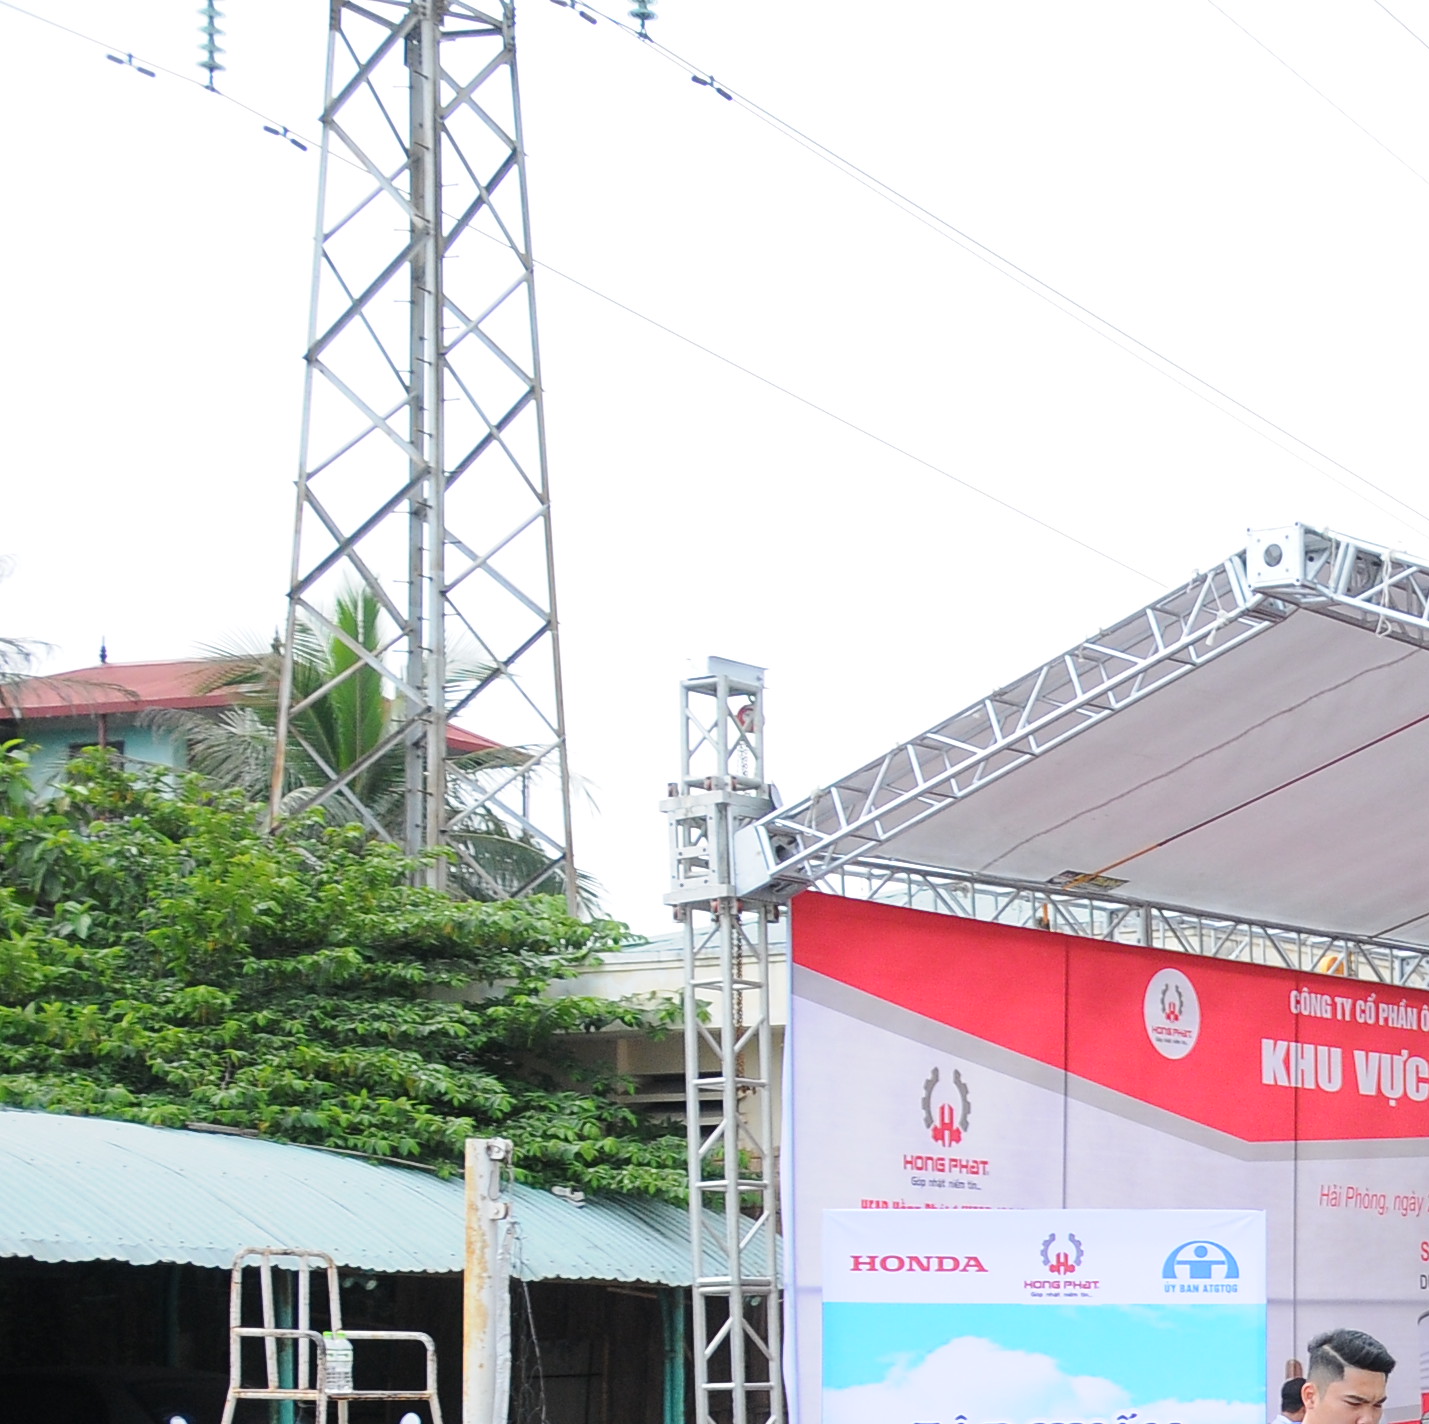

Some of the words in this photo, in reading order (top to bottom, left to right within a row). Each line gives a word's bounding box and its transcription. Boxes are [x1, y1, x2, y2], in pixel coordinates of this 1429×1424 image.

[1290, 987, 1332, 1019] CÔNG
[1334, 996, 1353, 1021] TY
[1355, 993, 1376, 1024] CỔ
[1421, 1004, 1429, 1032] Ô
[1261, 1038, 1343, 1093] KHU
[1353, 1049, 1429, 1107] VỰC
[1319, 1184, 1341, 1208] Hải
[1346, 1186, 1389, 1215] Phòng,
[1394, 1191, 1424, 1217] ngày
[849, 1255, 989, 1273] HONDA
[1179, 1284, 1200, 1293] BAN
